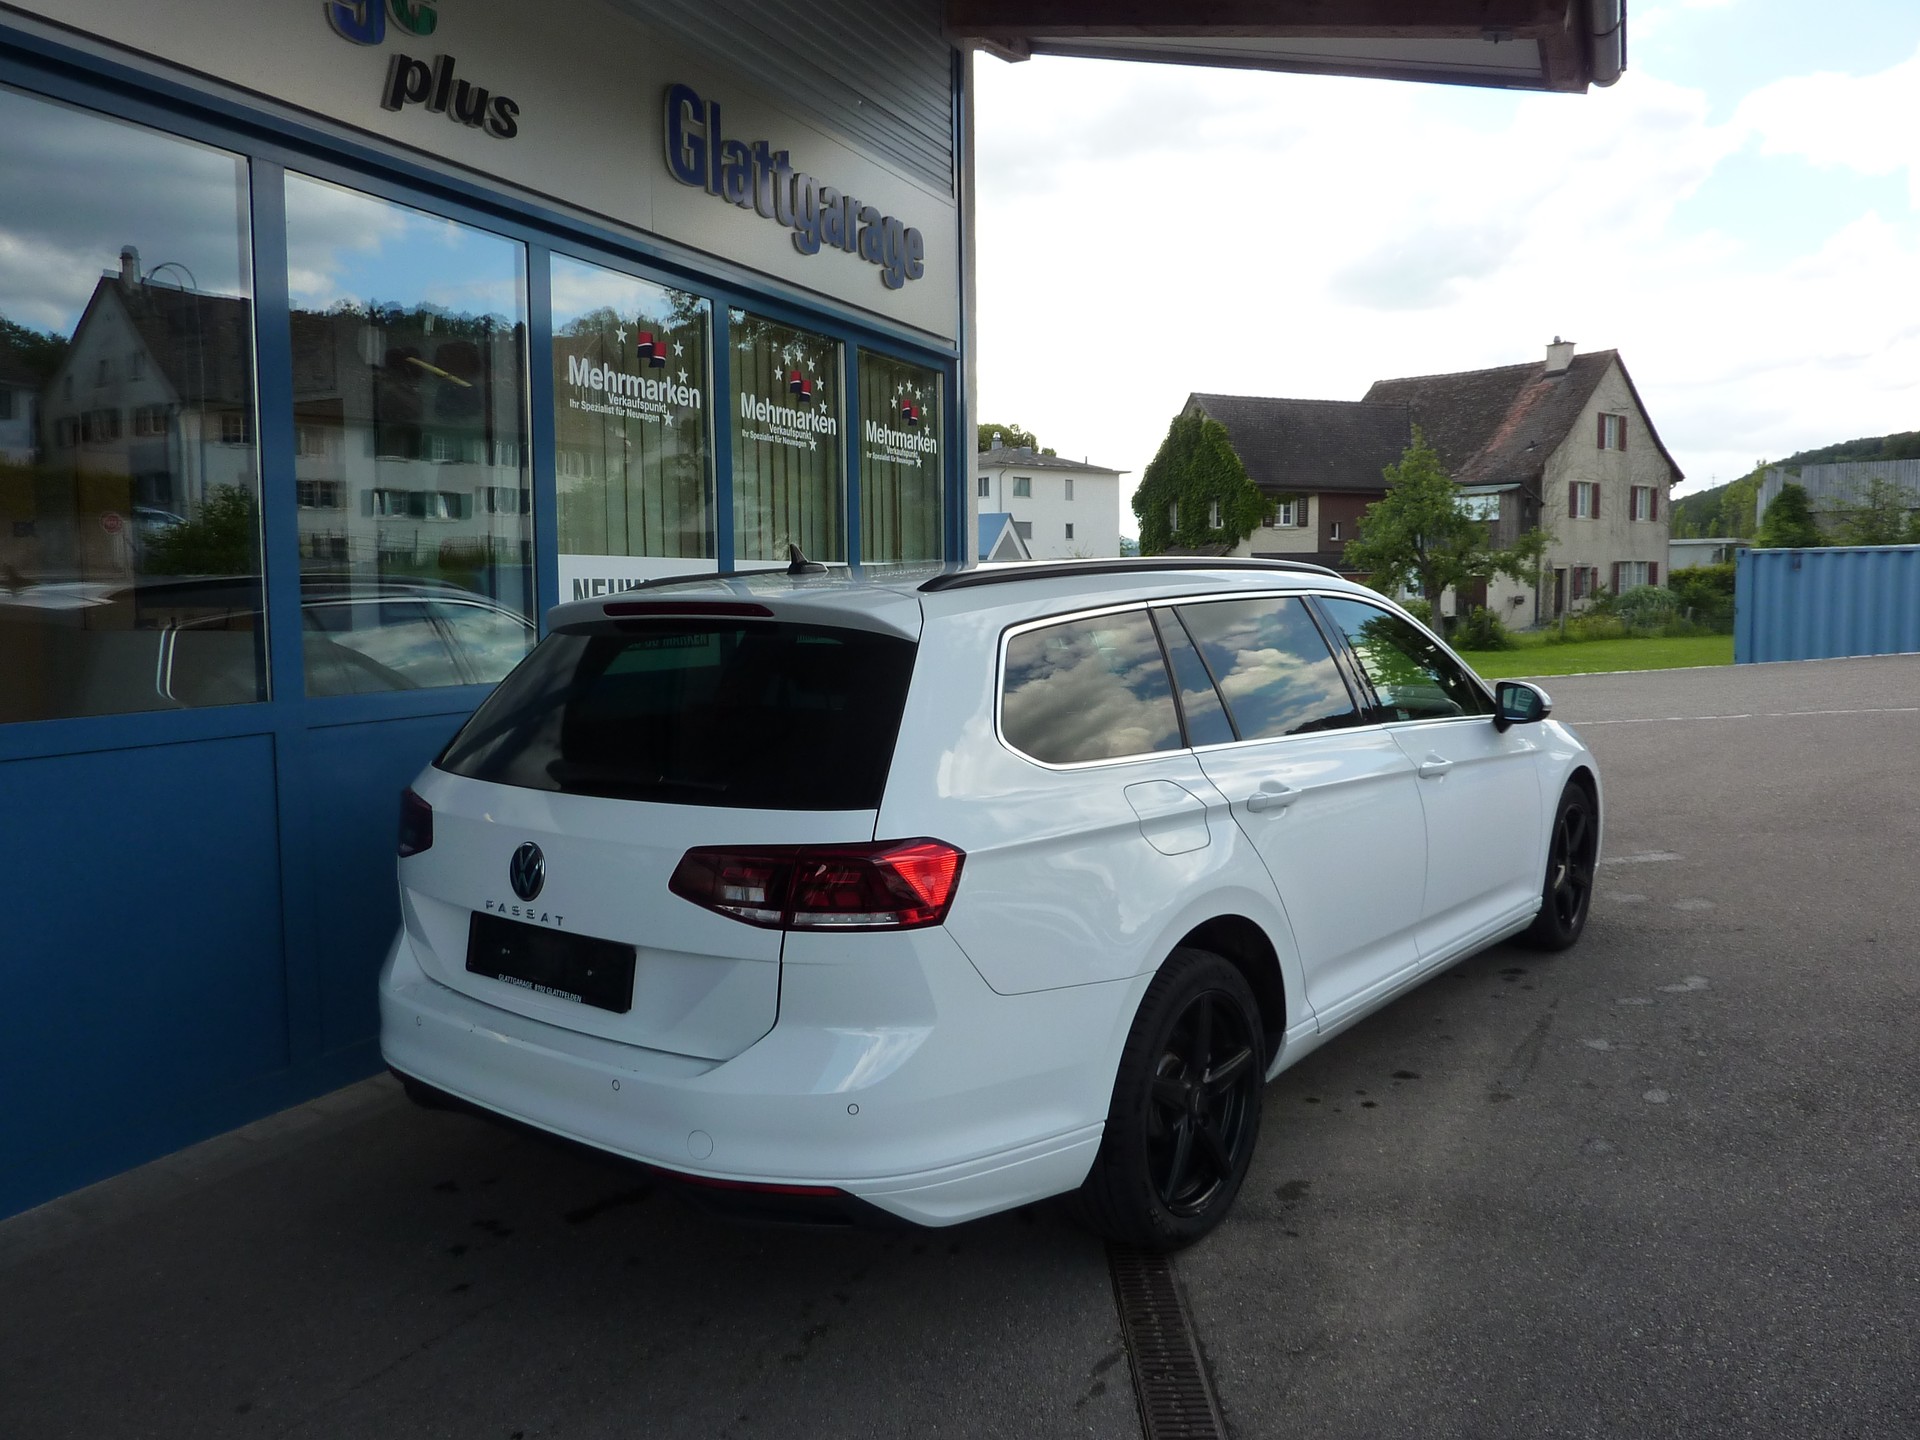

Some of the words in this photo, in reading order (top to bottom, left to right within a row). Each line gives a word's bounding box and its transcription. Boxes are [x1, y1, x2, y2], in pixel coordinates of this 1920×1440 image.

[382, 53, 520, 140] plus
[664, 82, 925, 290] Glattgarage
[568, 355, 700, 409] Mehrmarken
[569, 398, 579, 409] Ihr
[581, 400, 614, 415] Spezialist
[615, 406, 625, 416] für
[626, 408, 660, 423] Neuwagen
[608, 392, 667, 414] Verkaufspunkt
[740, 392, 837, 436] Mehrmarken
[750, 430, 774, 442] Spezialist
[769, 423, 812, 440] Verkaufspunkt
[865, 419, 937, 454] Mehrmarken
[485, 899, 564, 926] PASSAT
[498, 973, 533, 990] GLATTGARAGE
[546, 987, 582, 1003] GLATTFELDEN
